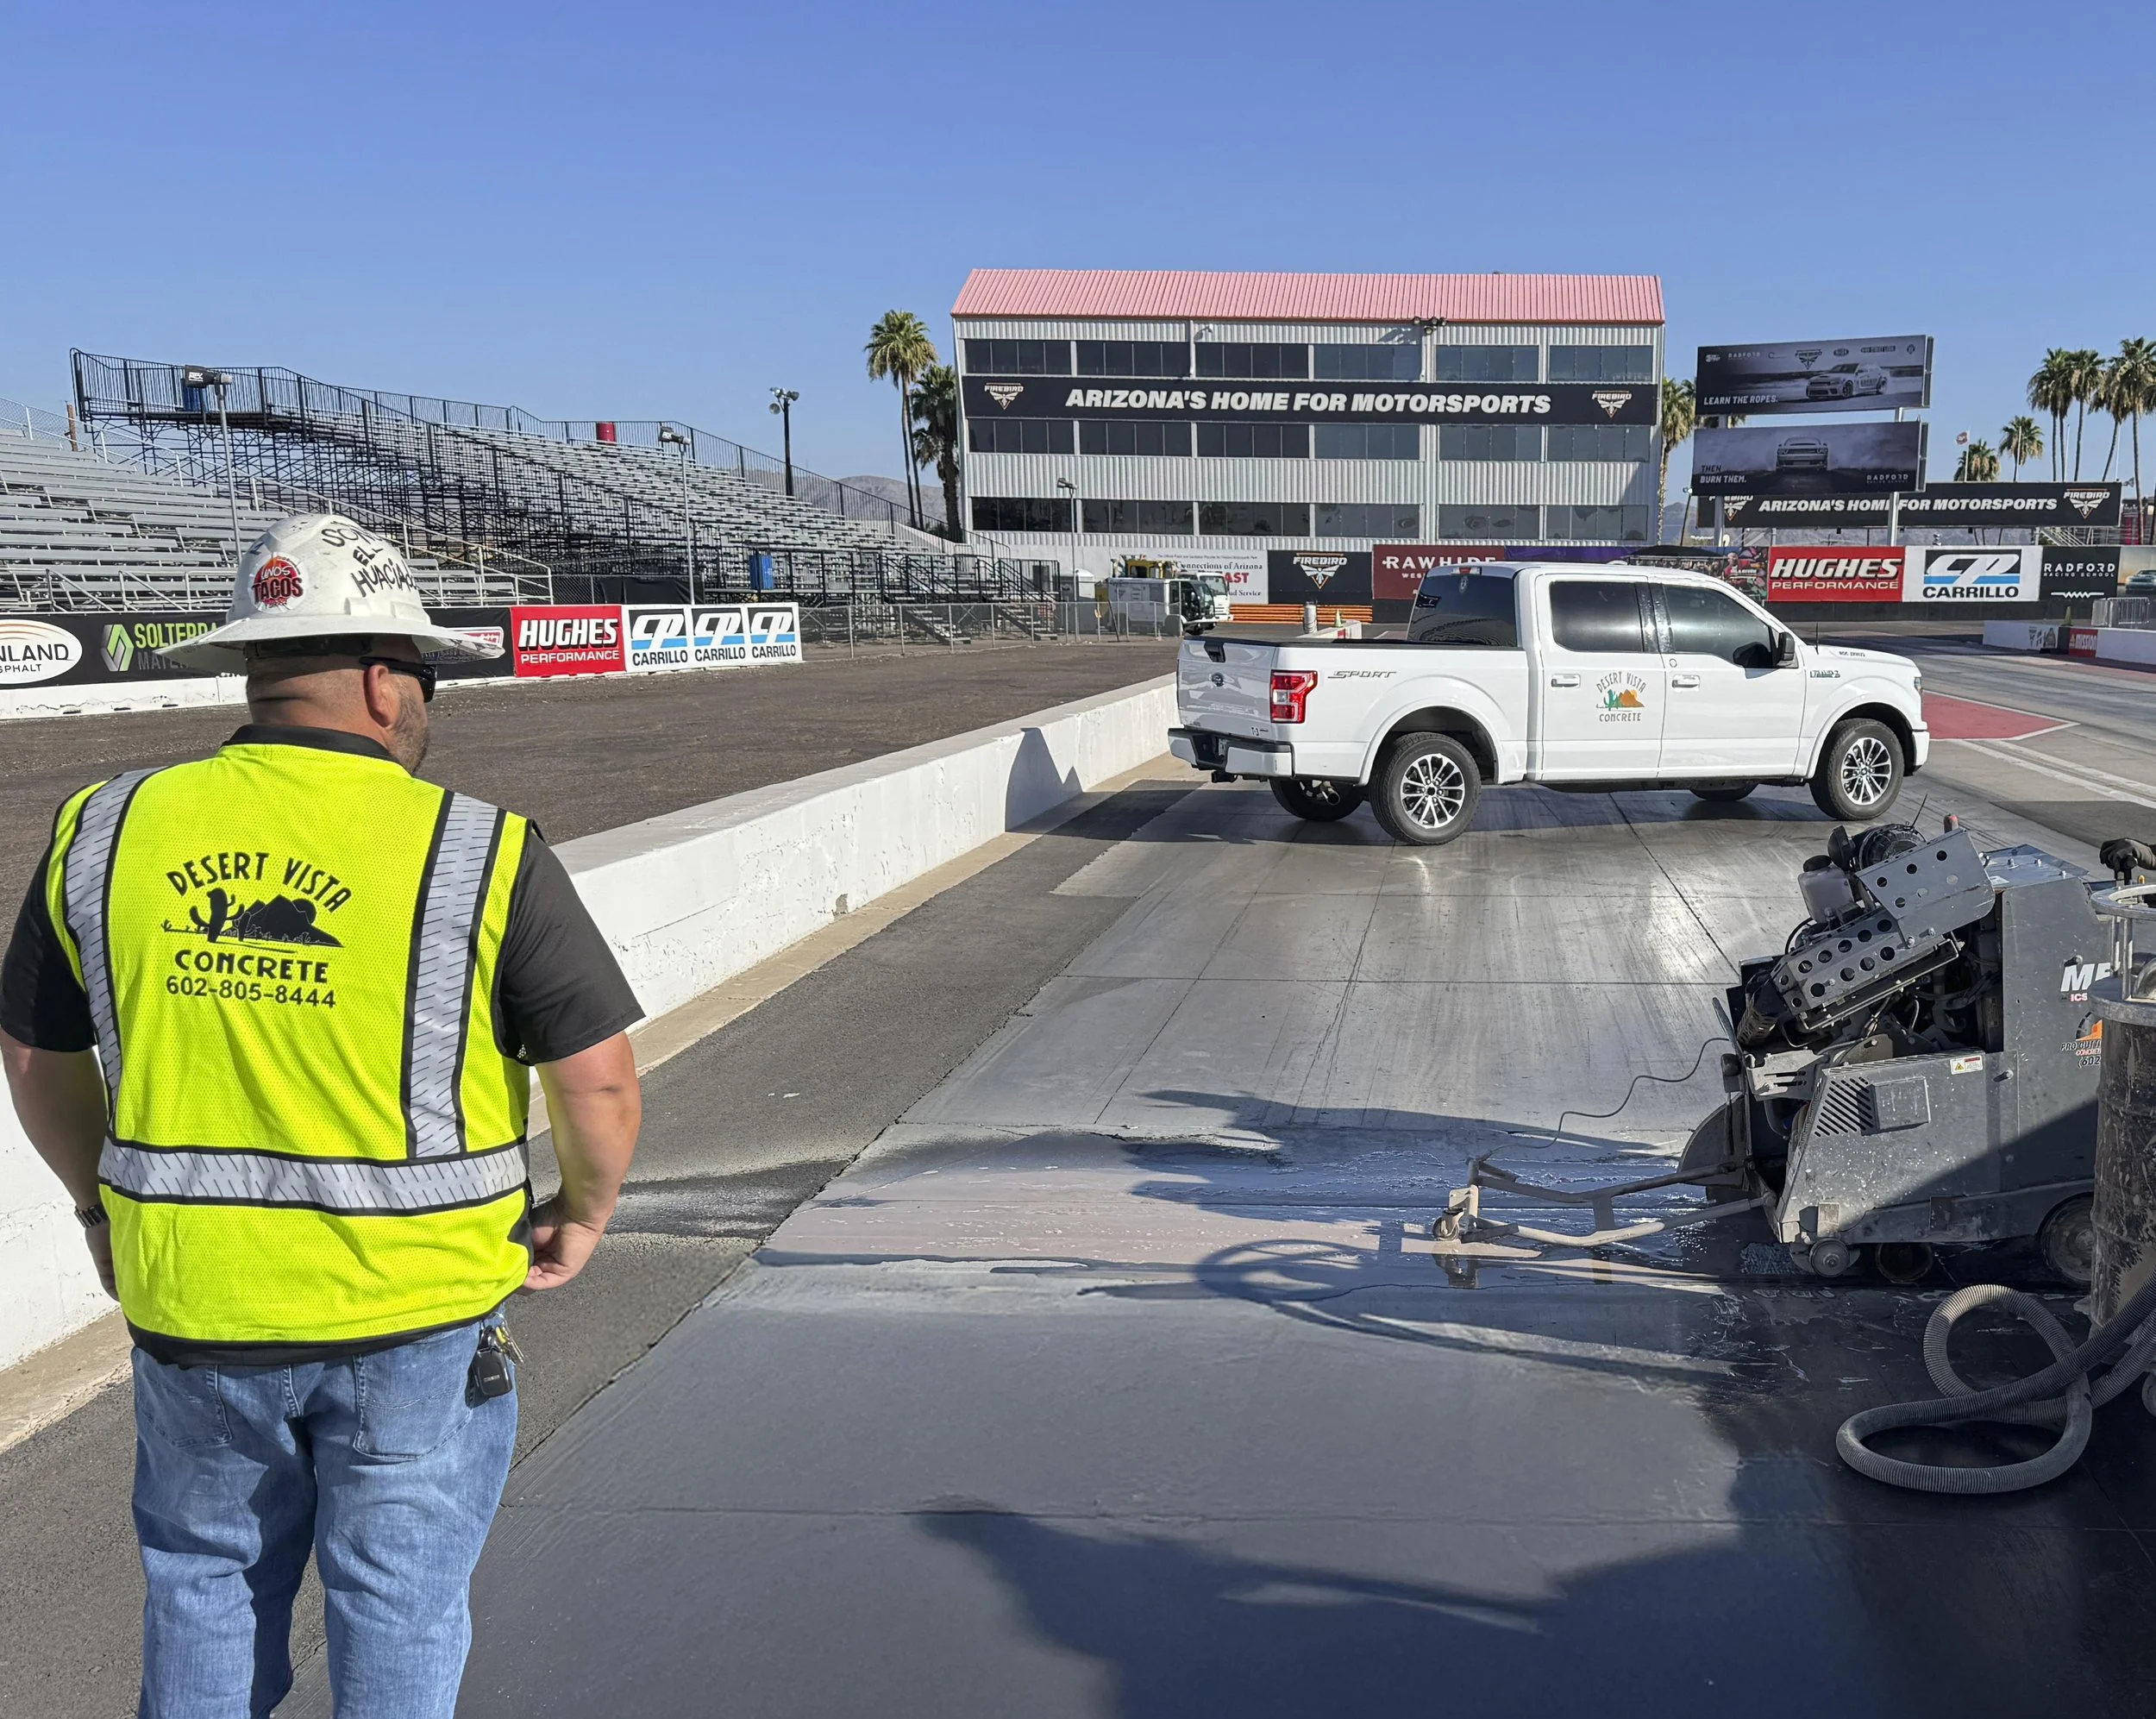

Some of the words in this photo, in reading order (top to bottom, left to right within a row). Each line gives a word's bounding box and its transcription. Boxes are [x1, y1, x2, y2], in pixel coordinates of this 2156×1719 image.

[1065, 389, 1206, 410] ARIZONA'S
[1211, 392, 1289, 411] HOME
[1294, 392, 1347, 411] FOR
[1351, 393, 1551, 414] MOTORSPORTS
[1703, 397, 1732, 405] LEARN
[1733, 396, 1748, 405] THE
[1750, 395, 1778, 404] ROPES.
[1700, 475, 1722, 484] BURN
[1758, 499, 1845, 511] ARIZONA'S
[1896, 499, 1931, 511] FOR
[1933, 499, 2057, 511] MOTORSPORTS
[1293, 556, 1347, 566] FIREBIRD
[2044, 563, 2115, 572] RADFORD
[1770, 558, 1902, 580] HUGHES
[251, 577, 304, 604] TACOS
[1923, 586, 2019, 598] CARRILLO
[518, 618, 618, 651] HUGHES
[521, 649, 619, 664] PERFORMANCE
[632, 649, 688, 667] CARRILLO
[694, 646, 746, 662] CARRILLO
[752, 644, 796, 658] CARRILLO
[1328, 670, 1397, 679] SPORT
[1596, 671, 1621, 693] DESERT
[1626, 672, 1647, 693] VISTA
[1599, 712, 1641, 722] CONCRETE
[165, 851, 269, 897] DESERT
[282, 856, 352, 914] VISTA
[174, 950, 329, 983] CONCRETE
[166, 976, 336, 1008] 602-805-8444
[2078, 1055, 2101, 1068] (602
